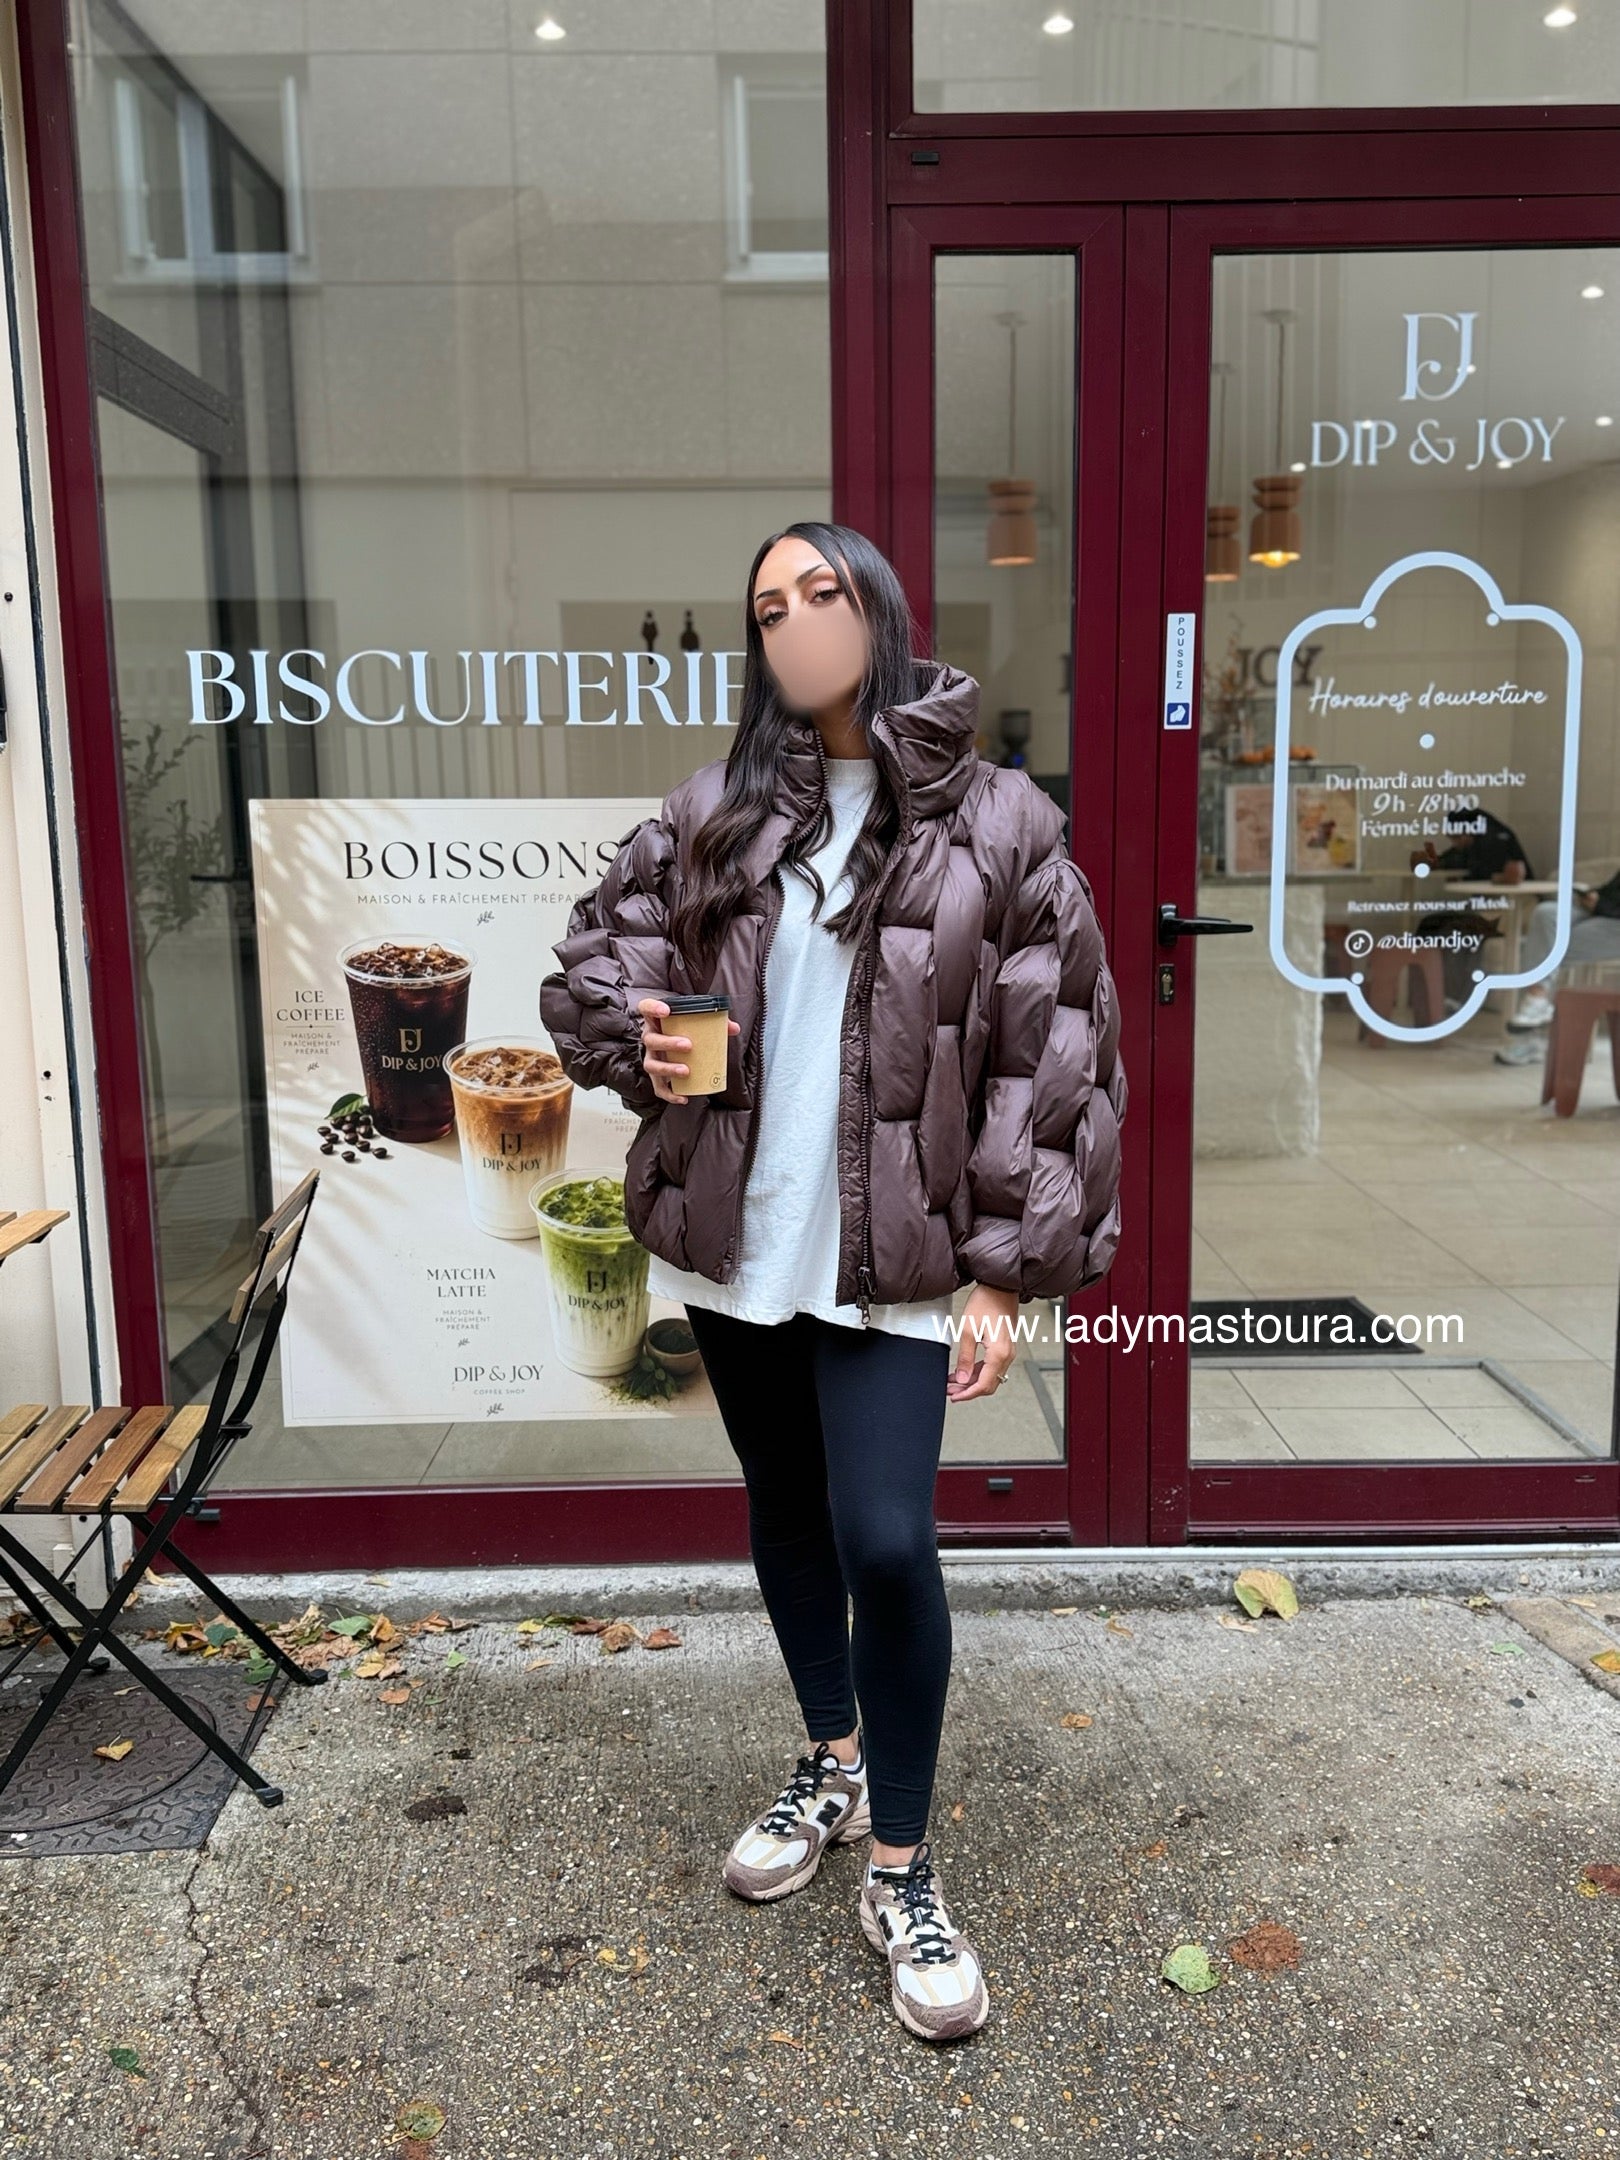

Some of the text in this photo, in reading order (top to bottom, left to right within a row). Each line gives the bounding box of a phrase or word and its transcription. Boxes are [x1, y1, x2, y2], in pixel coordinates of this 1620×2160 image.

[1311, 416, 1565, 470] DIP & JOY
[1176, 617, 1185, 689] POUSSEZ
[185, 649, 747, 726] BISCUITERIE
[1325, 767, 1526, 791] Du mardi au dimanche
[1423, 816, 1440, 835] le
[1442, 815, 1488, 835] lundi
[344, 841, 620, 879] BOISSONS
[357, 892, 580, 905] MAISON & FRAÎCHEMENT PRÉPAR
[1377, 931, 1483, 953] @dipandjoy
[295, 990, 325, 1003] ICE
[276, 1008, 346, 1022] COFFEE
[283, 1039, 341, 1047] FRAÎCHEMENT
[381, 1055, 442, 1072] DIP & JOY
[483, 1157, 542, 1173] DIP & JOY
[427, 1269, 496, 1280] MATCHA
[438, 1285, 487, 1298] LATTE
[568, 1295, 627, 1312] DIP & JOY
[454, 1364, 544, 1383] DIP & JOY
